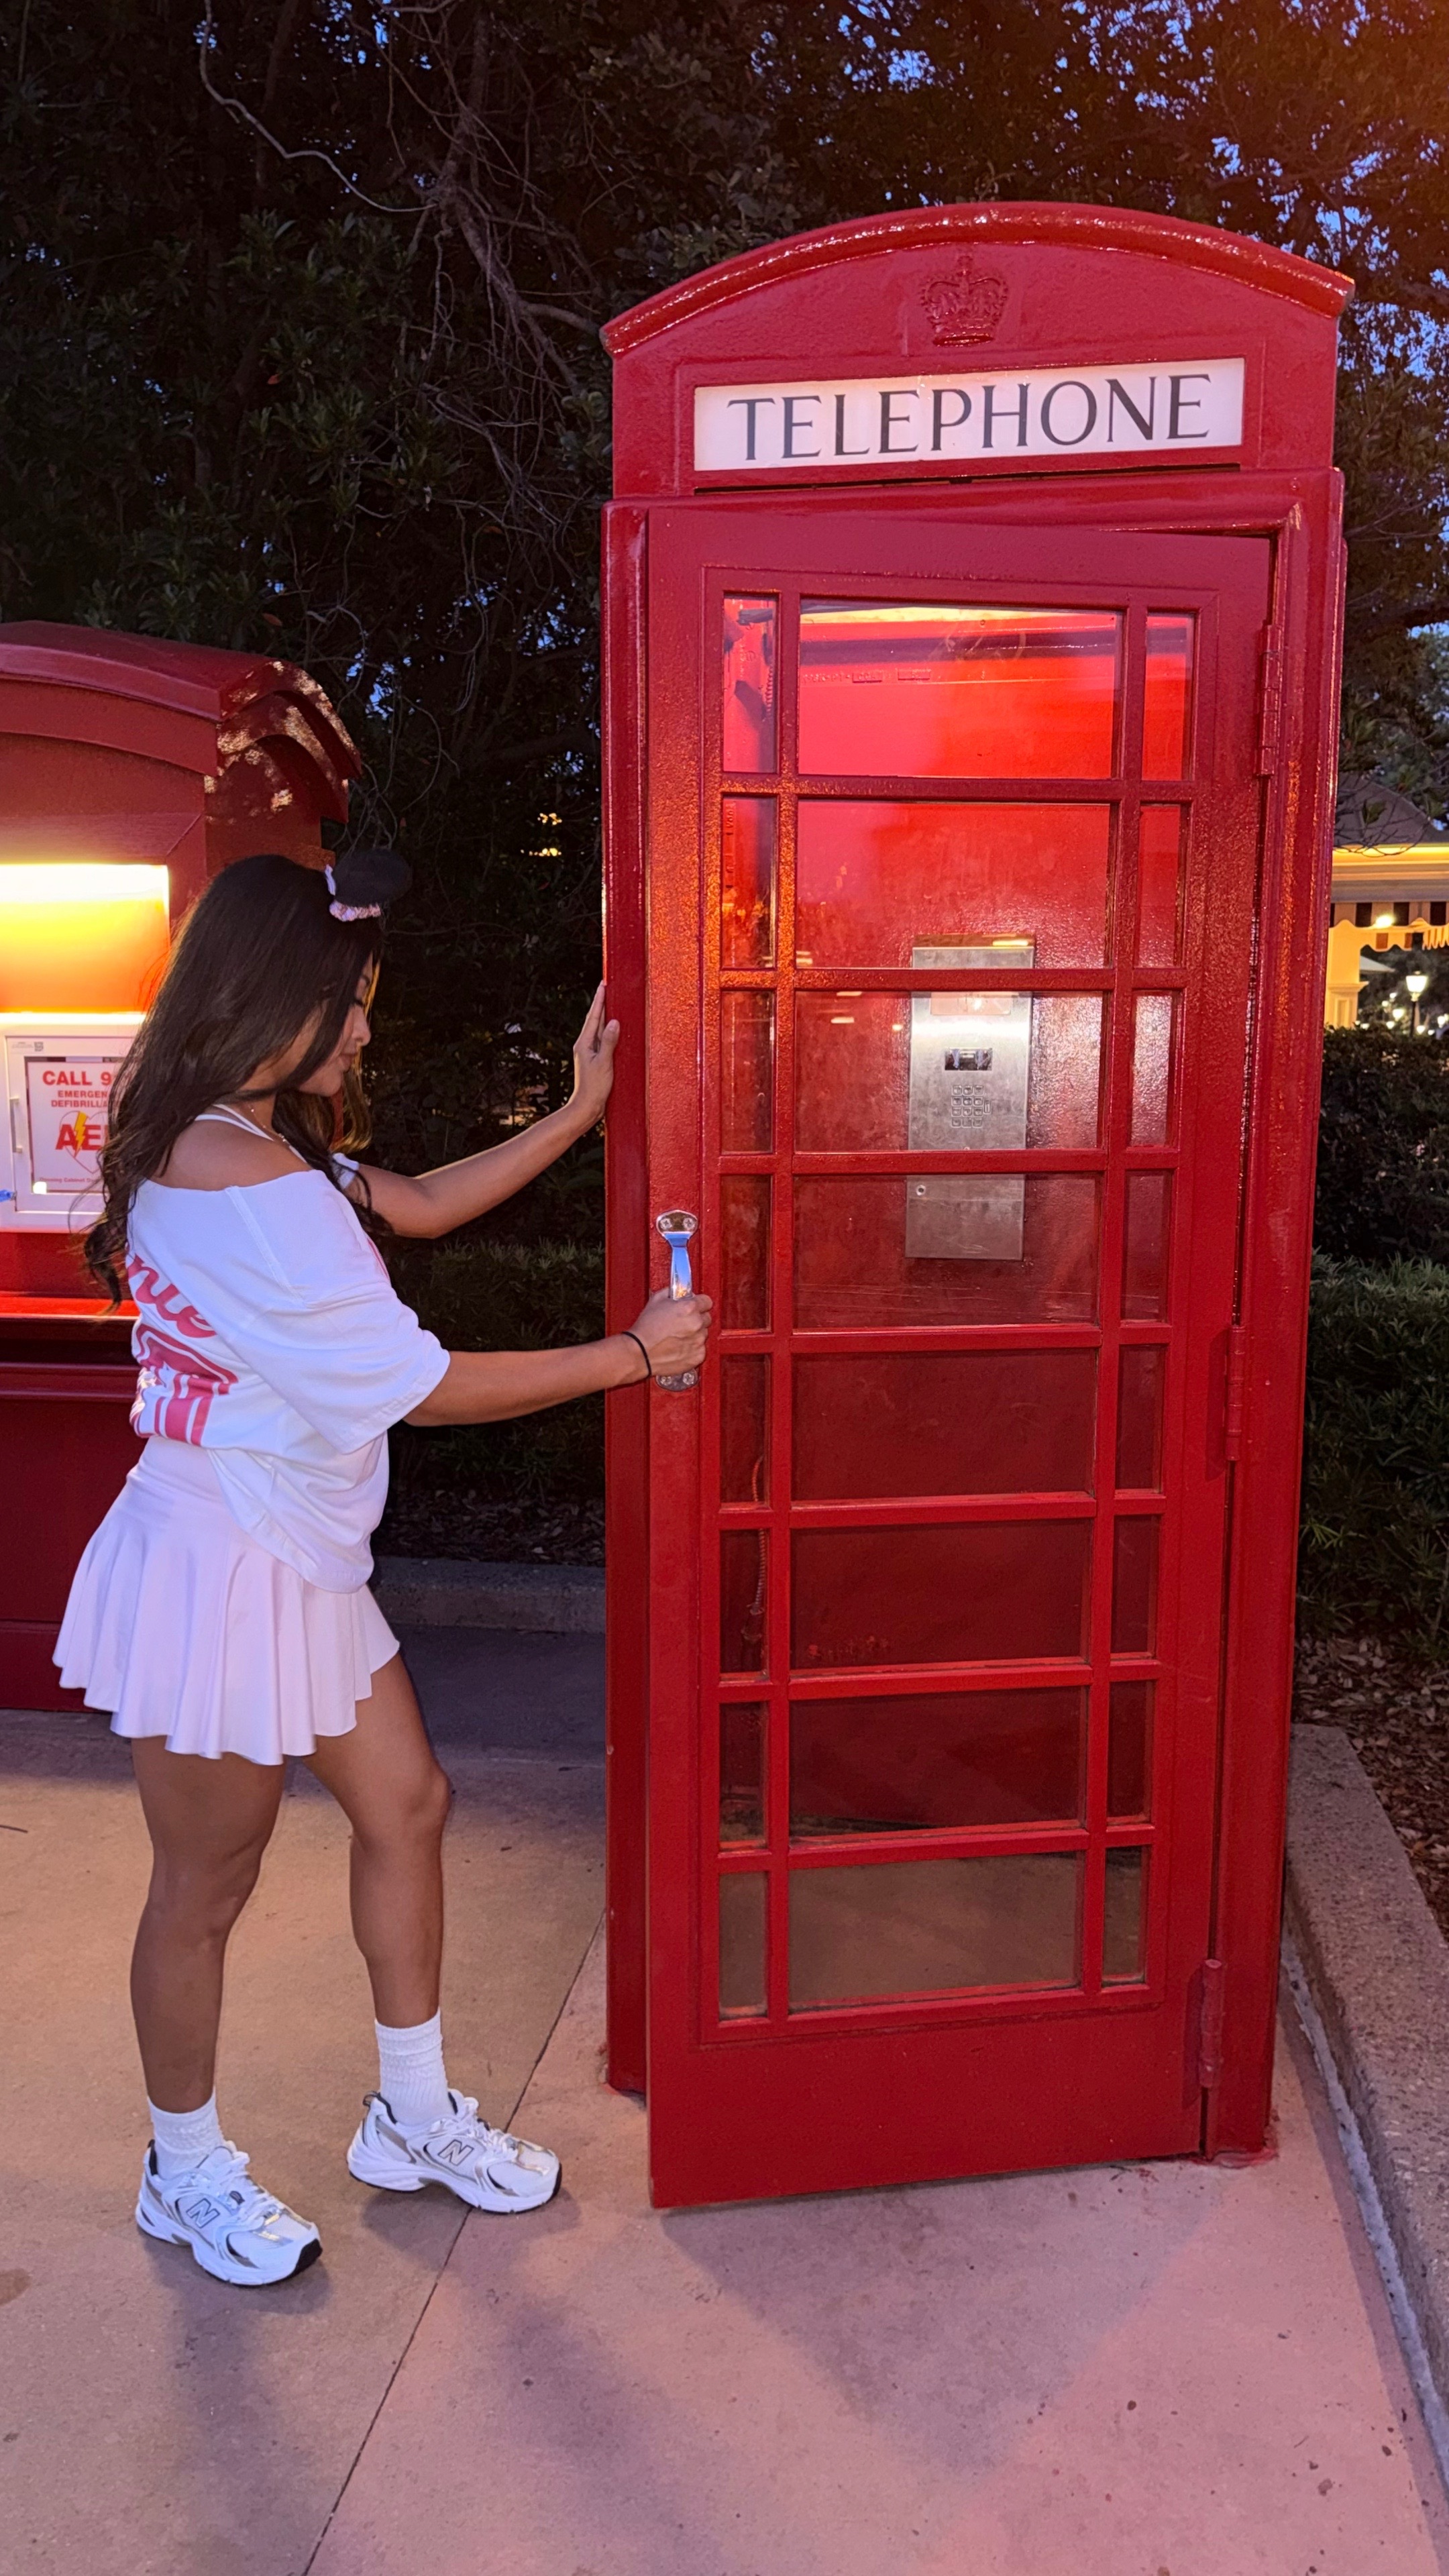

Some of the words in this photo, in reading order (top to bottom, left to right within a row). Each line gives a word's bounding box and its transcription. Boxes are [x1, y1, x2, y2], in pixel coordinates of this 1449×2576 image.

[727, 374, 1211, 460] TELEPHONE
[42, 1071, 93, 1085] CALL
[58, 1090, 108, 1098] EMERGEN
[55, 1124, 110, 1150] AE
[437, 2139, 474, 2167] N
[186, 2198, 221, 2229] N
